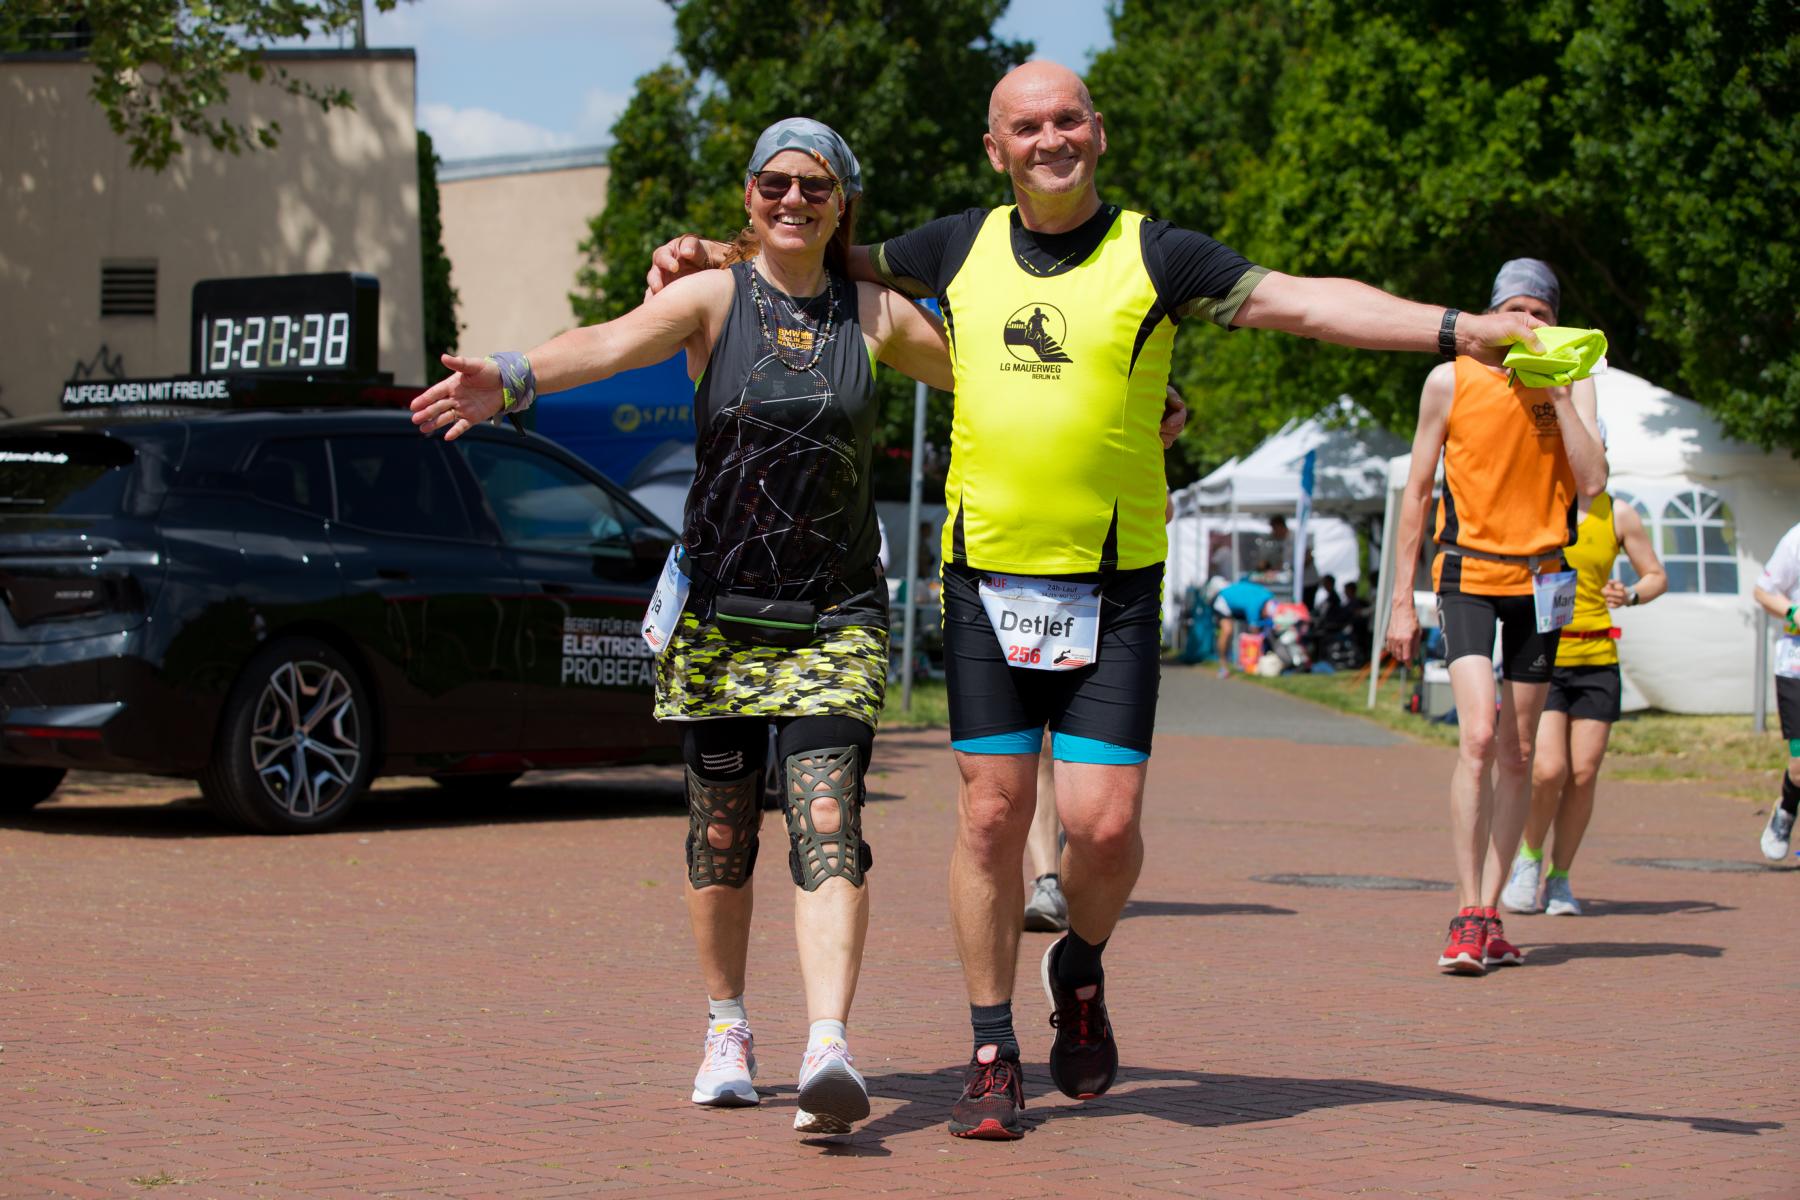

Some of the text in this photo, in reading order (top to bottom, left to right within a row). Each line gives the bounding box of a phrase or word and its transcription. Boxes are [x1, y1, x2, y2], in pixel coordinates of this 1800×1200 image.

[778, 328, 801, 339] BMW
[999, 363, 1062, 374] LG MAUERWEG
[63, 380, 230, 404] AUFGELADEN MIT FREUDE.
[1000, 610, 1075, 638] Detlef
[1007, 644, 1041, 665] 256
